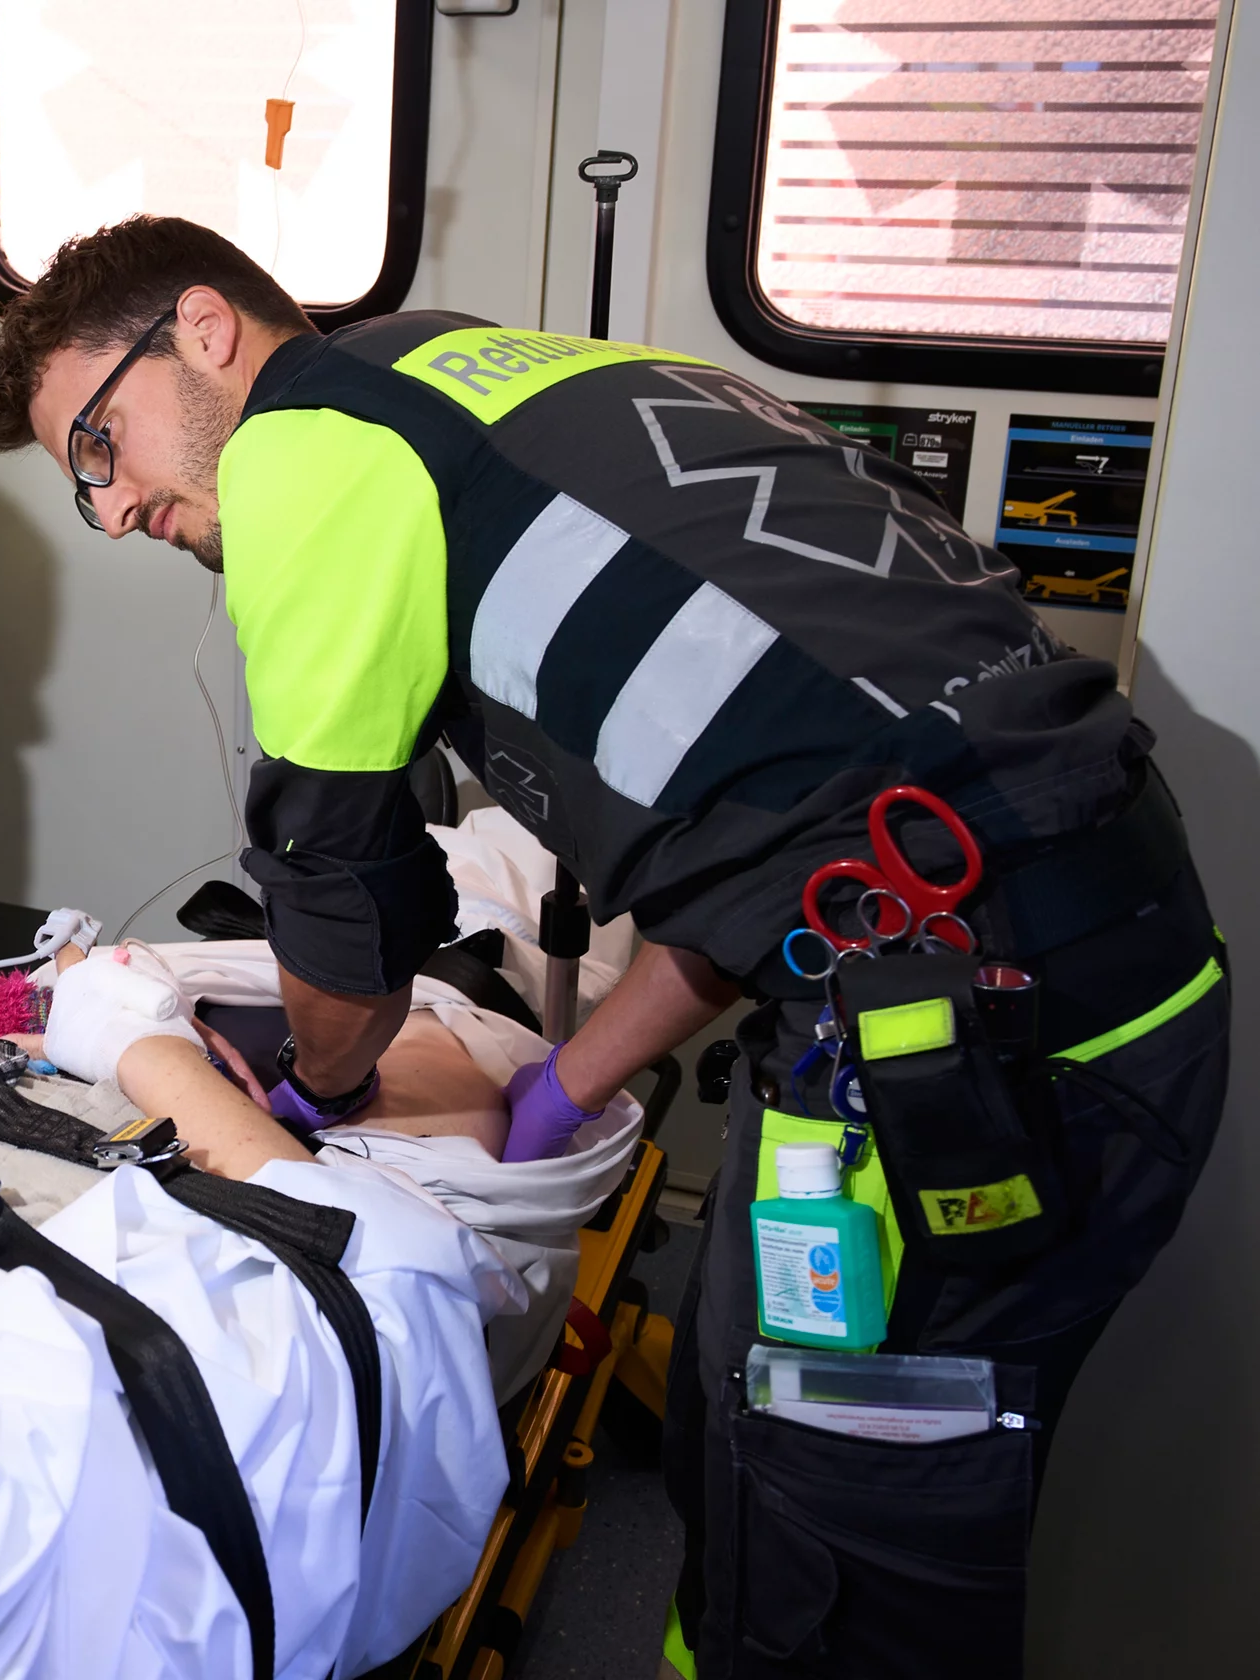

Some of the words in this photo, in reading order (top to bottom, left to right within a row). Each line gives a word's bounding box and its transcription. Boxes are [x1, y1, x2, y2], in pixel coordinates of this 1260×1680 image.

[927, 412, 972, 424] stryker
[839, 424, 871, 433] Einladen
[1051, 421, 1095, 431] MANUELLER
[1070, 434, 1104, 444] Einladen
[1055, 537, 1090, 546] Ausladen
